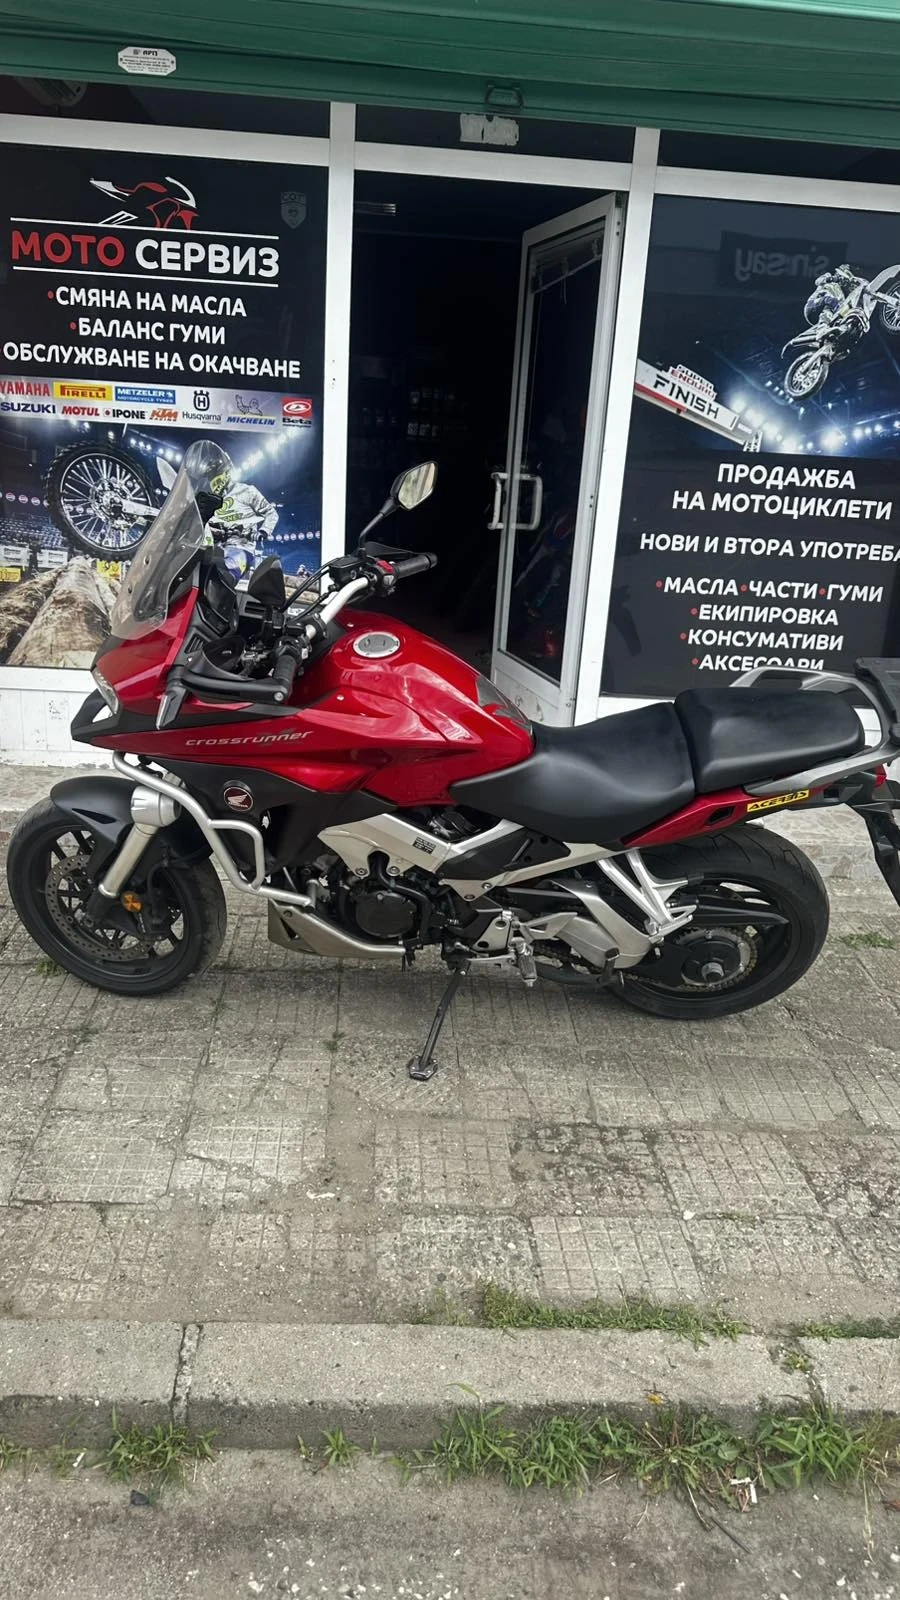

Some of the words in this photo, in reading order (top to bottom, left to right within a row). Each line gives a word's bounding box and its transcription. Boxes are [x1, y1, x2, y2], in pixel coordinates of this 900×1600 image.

[11, 231, 125, 267] МОТО
[135, 239, 280, 277] СЕРВИЗ
[55, 286, 132, 309] СМЯНА
[136, 291, 166, 312] НА
[171, 294, 247, 316] МАСЛА
[78, 317, 164, 341] БАЛАНС
[169, 323, 225, 344] ГУМИ
[3, 342, 150, 368] ОБСЛУЖВАНЕ
[155, 351, 184, 371] НА
[188, 354, 301, 379] ОКАЧВАНЕ
[0, 381, 50, 397] YAMAHA
[60, 385, 106, 399] PIRELLI
[117, 388, 165, 397] METZELER
[653, 373, 719, 419] FINISH
[0, 401, 56, 414] SUZUKI
[62, 405, 100, 417] MOTUL
[112, 409, 146, 420] IPONE
[151, 409, 178, 418] KTM
[182, 411, 222, 421] Husqvarna
[227, 416, 275, 426] MICHELIN
[282, 417, 312, 425] Beta
[717, 463, 856, 490] ПРОДАЖБА
[672, 490, 706, 511] НА
[711, 492, 893, 520] МОТОЦИКЛЕТИ
[640, 533, 700, 552] НОВИ
[703, 536, 719, 553] И
[723, 537, 795, 557] ВТОРА
[663, 577, 739, 596] МАСЛА
[749, 581, 818, 600] ЧАСТИ
[826, 584, 884, 603] ГУМИ
[698, 604, 839, 626] ЕКИПИРОВКА
[687, 629, 844, 651] КОНСУМАТИВИ
[185, 731, 314, 746] crossrunner
